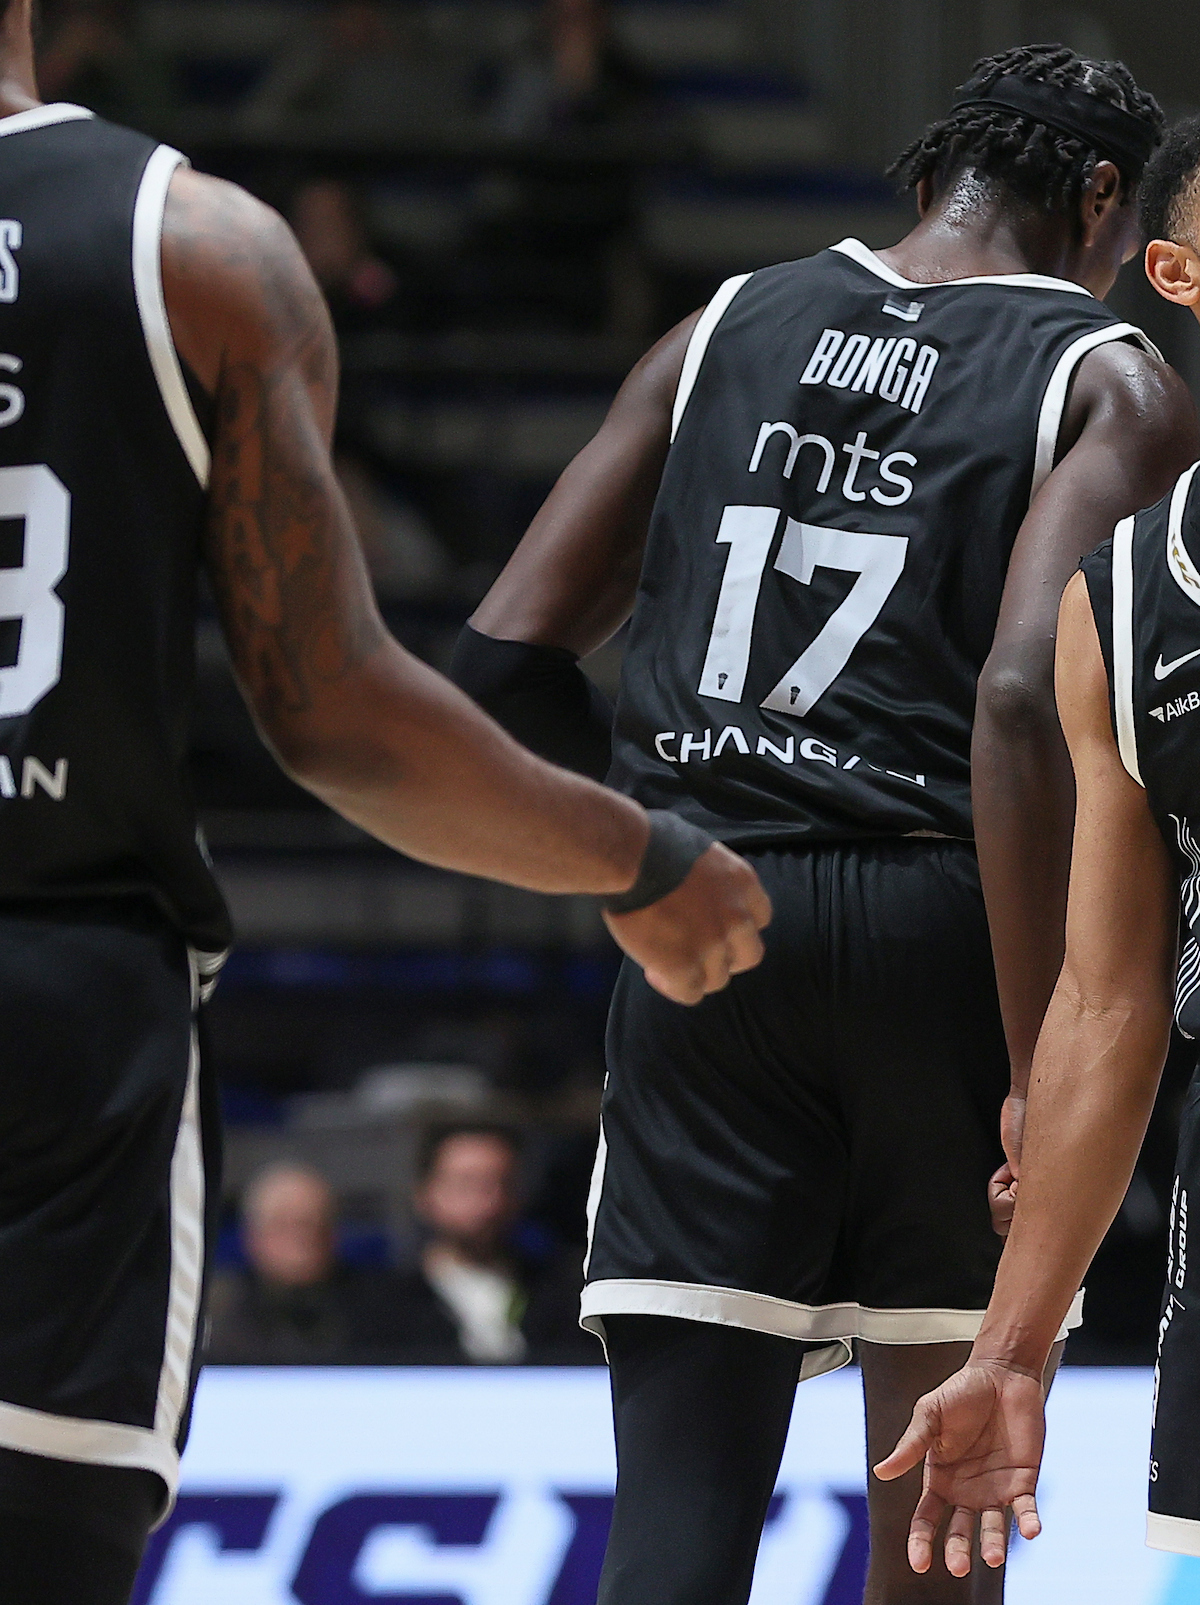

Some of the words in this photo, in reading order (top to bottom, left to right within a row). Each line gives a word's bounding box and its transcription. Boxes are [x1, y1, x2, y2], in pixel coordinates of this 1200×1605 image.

[799, 328, 940, 415] BONGA
[748, 420, 918, 507] mts
[697, 502, 910, 717] 17
[1174, 1188, 1188, 1290] GROUP
